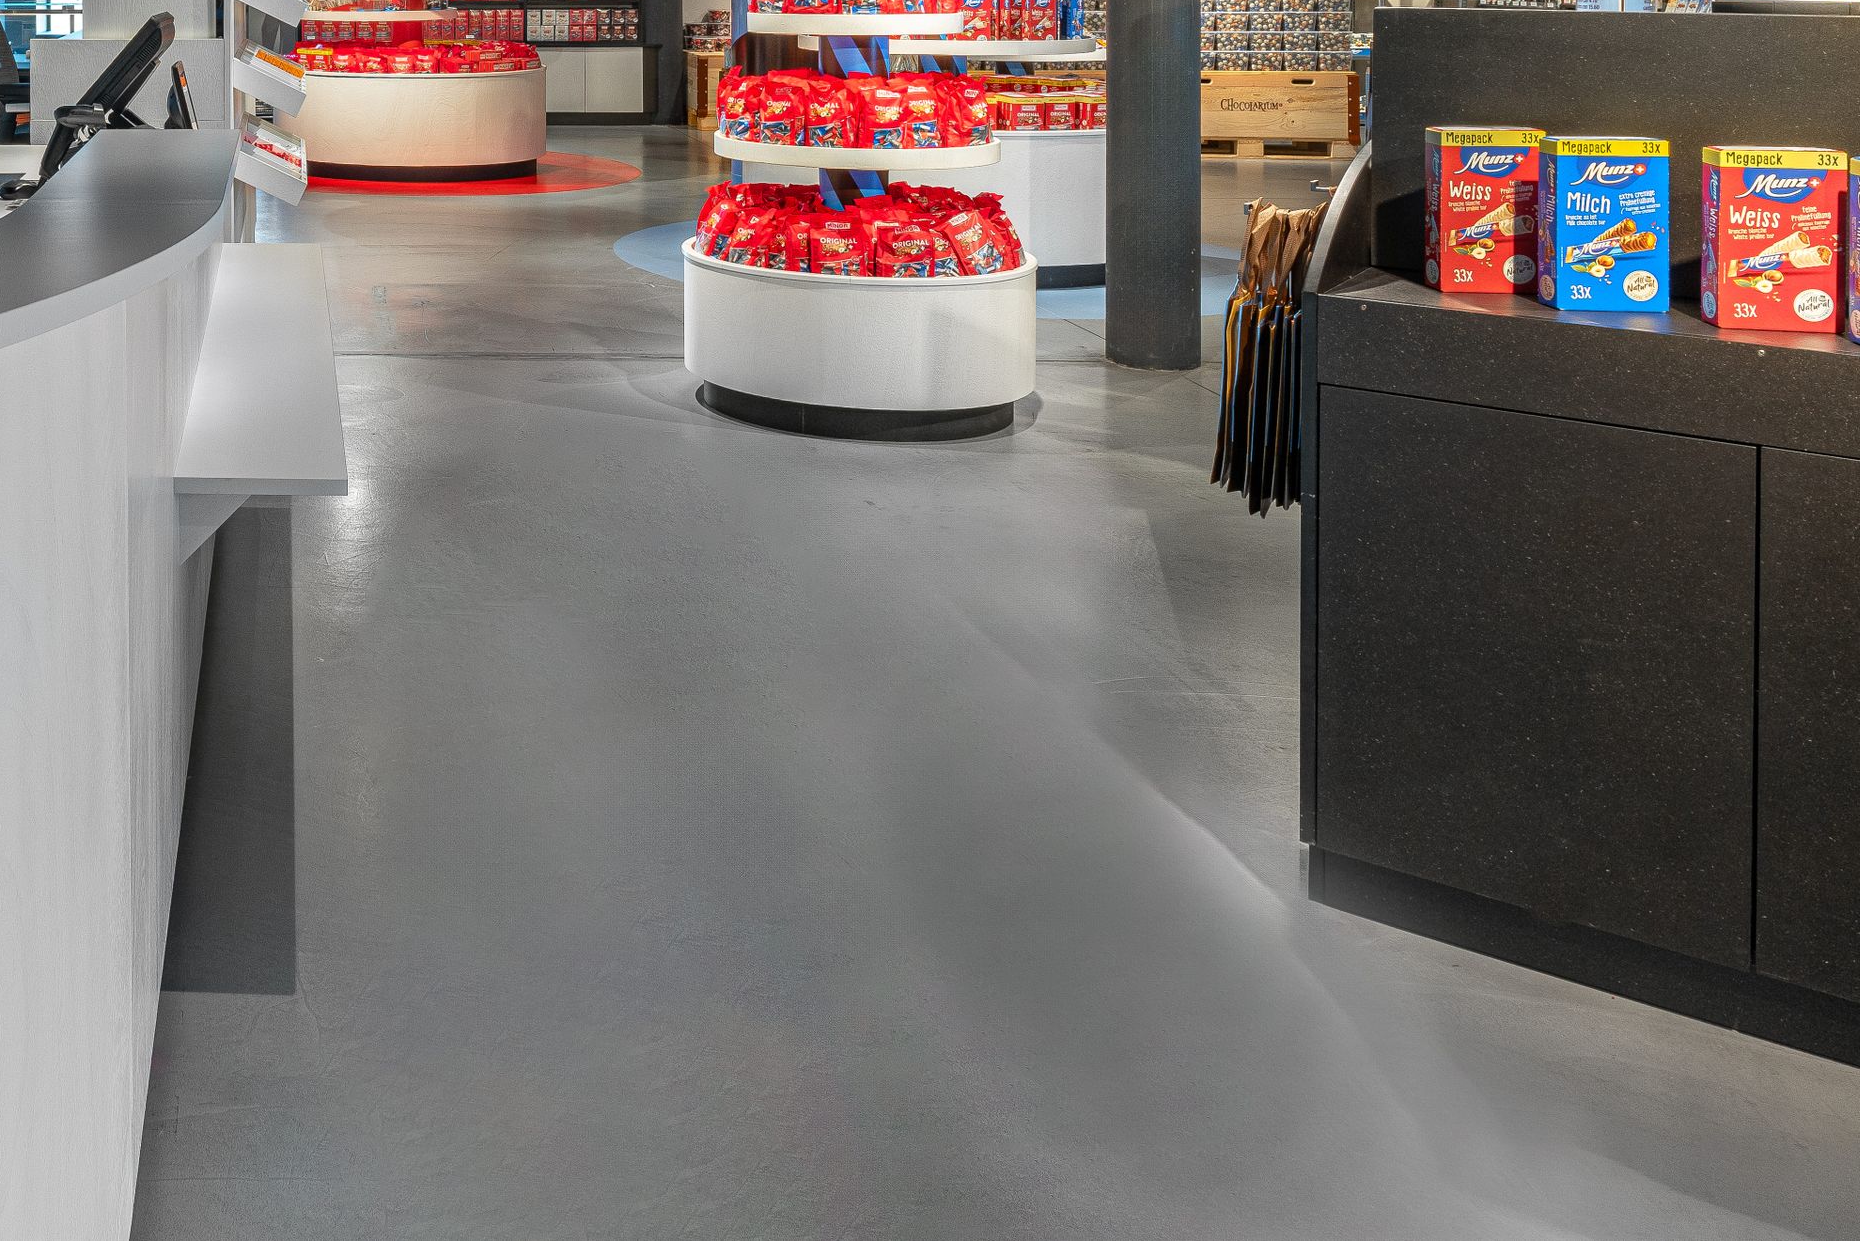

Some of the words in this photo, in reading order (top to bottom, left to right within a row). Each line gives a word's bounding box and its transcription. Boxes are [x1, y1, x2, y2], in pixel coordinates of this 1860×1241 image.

[1446, 130, 1493, 146] Megapack
[1521, 133, 1539, 144] 33x
[1562, 141, 1612, 155] Megapack
[1642, 142, 1661, 154] 33x
[1454, 151, 1514, 174] Munz
[1726, 152, 1783, 166] Megapack
[1817, 153, 1839, 167] 33x
[1570, 162, 1635, 186] Munz
[1449, 180, 1492, 201] Weiss
[1735, 174, 1809, 198] Munz
[1566, 191, 1611, 215] Milch
[1730, 205, 1781, 229] Weiss
[1457, 224, 1492, 240] Munz
[892, 239, 929, 248] ORIGINAL
[1577, 240, 1612, 255] Munz
[1740, 254, 1781, 271] Munz
[1453, 269, 1473, 283] 33x
[1570, 285, 1592, 299] 33x
[1627, 281, 1655, 294] Natural
[1733, 303, 1758, 318] 33x
[1798, 300, 1831, 312] Natural
